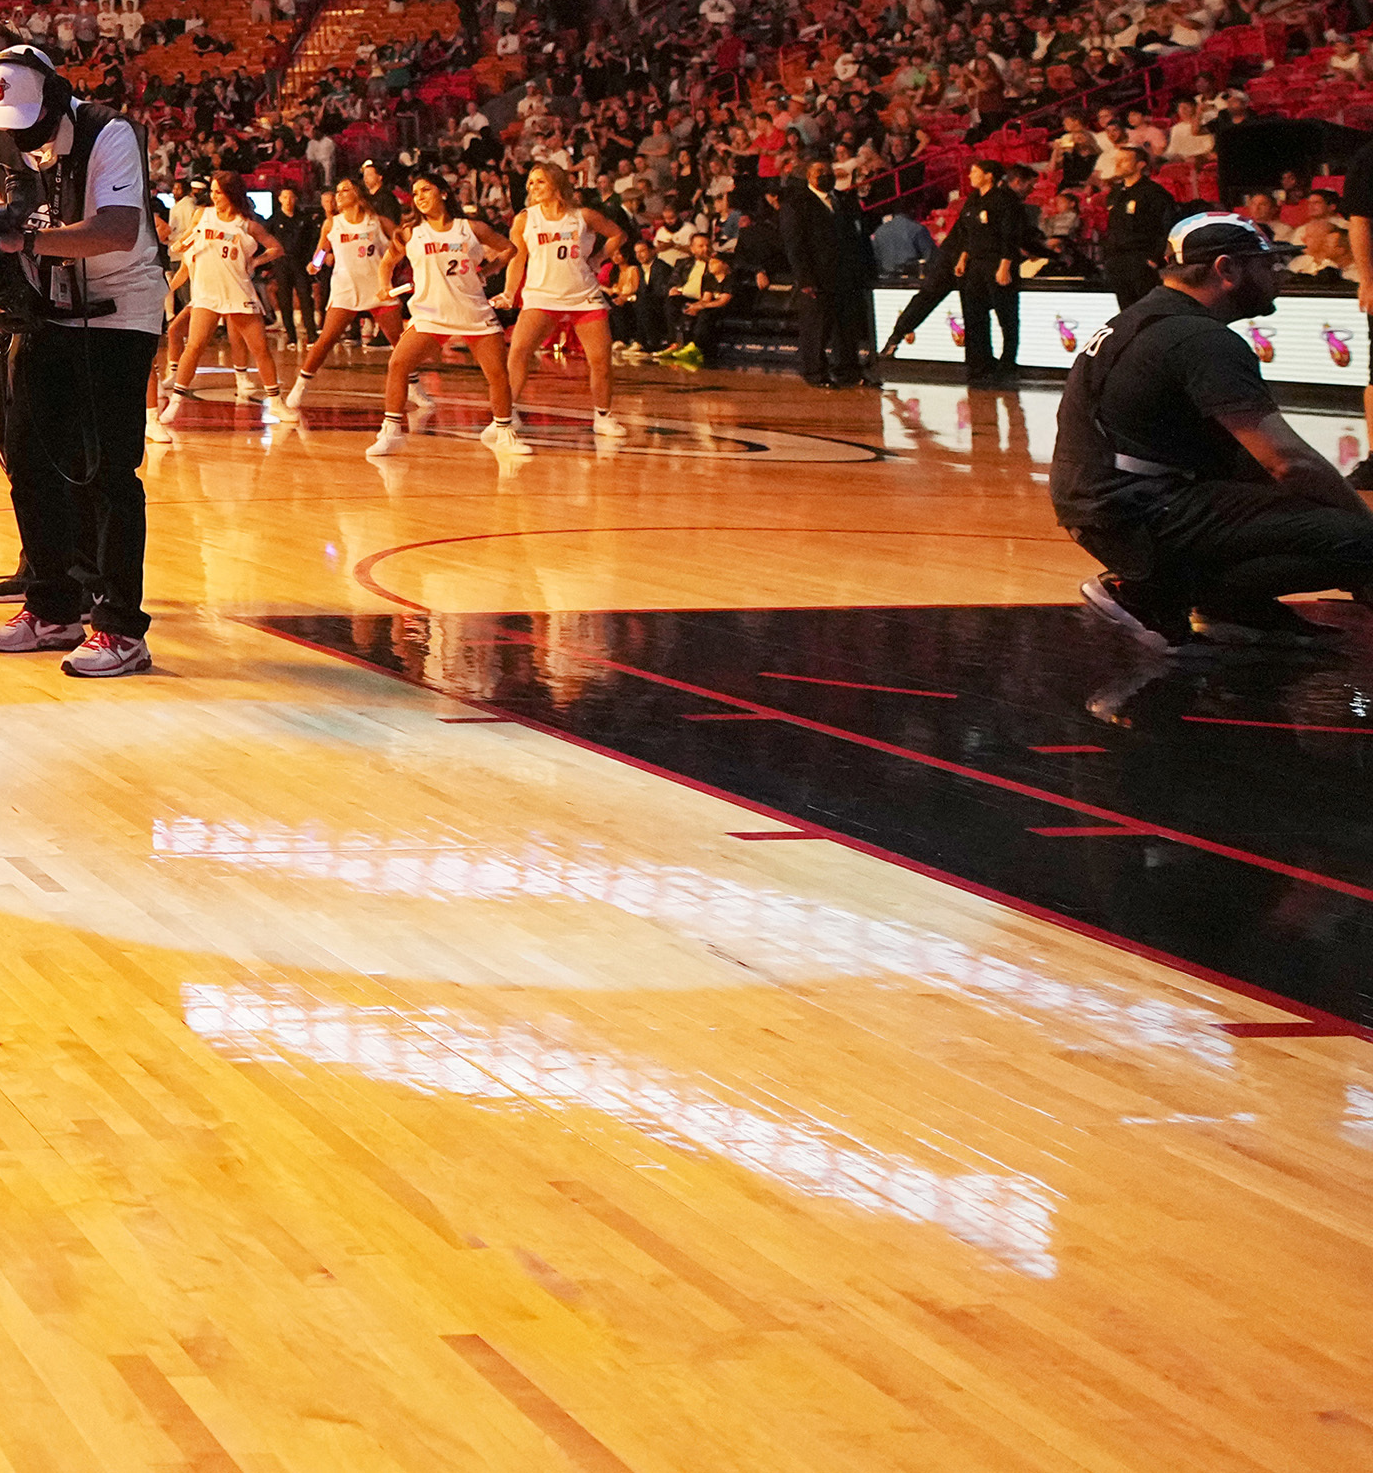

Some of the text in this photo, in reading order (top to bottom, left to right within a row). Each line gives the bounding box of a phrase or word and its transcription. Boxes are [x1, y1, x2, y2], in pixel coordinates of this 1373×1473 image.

[537, 231, 578, 246] MIAMI
[357, 244, 375, 258] 99
[424, 242, 468, 255] MIAMI
[557, 245, 580, 260] 06
[446, 259, 470, 276] 25
